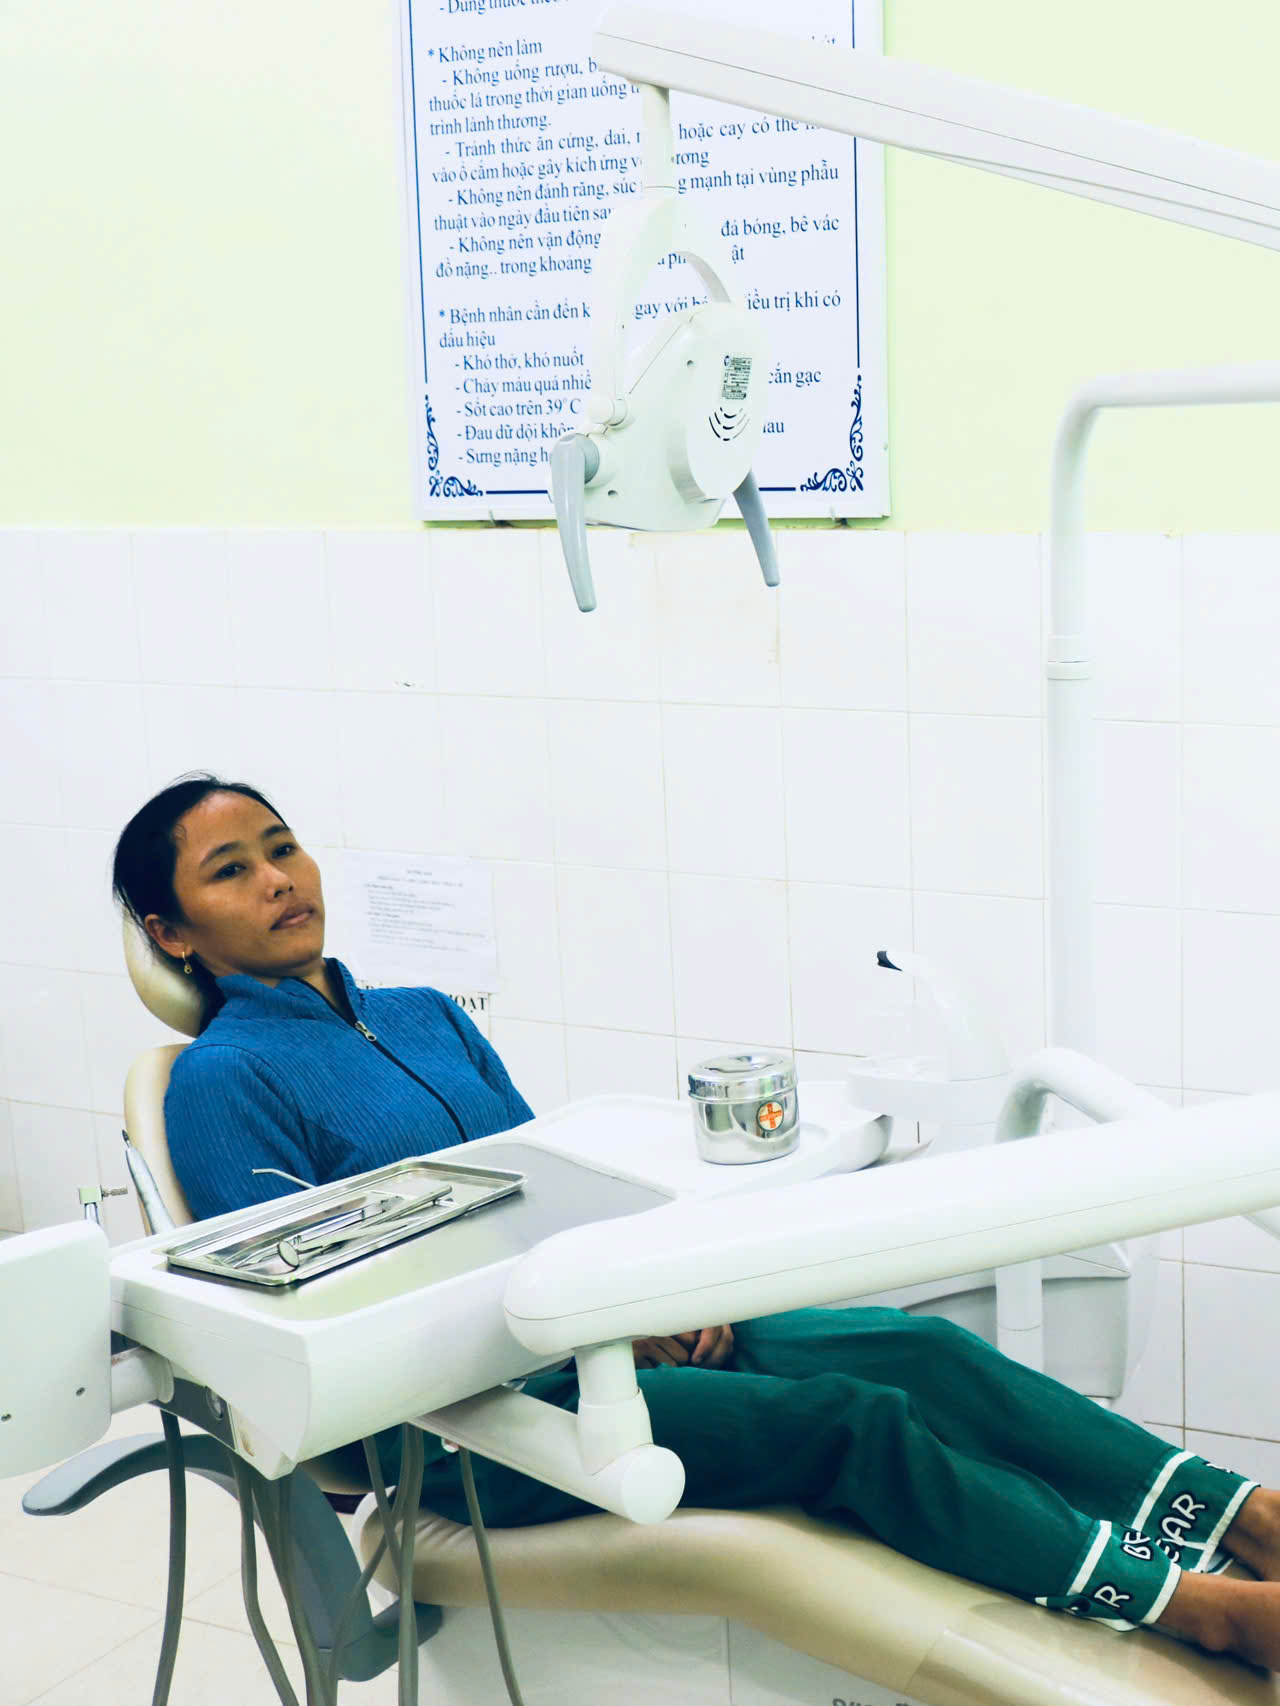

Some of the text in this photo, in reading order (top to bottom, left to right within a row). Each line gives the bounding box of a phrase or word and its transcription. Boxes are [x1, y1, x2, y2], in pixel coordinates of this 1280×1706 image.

[439, 45, 487, 63] Không
[488, 41, 513, 58] nên
[453, 66, 499, 86] Không
[470, 92, 483, 109] lá
[486, 92, 523, 109] trong
[557, 84, 588, 105] gian
[430, 118, 462, 136] trình
[455, 138, 496, 158] Tránh
[604, 128, 631, 146] dai,
[679, 123, 714, 142] hoặc
[719, 123, 746, 140] cay
[751, 116, 770, 134] có
[432, 167, 456, 183] vào
[502, 161, 534, 181] hoặc
[538, 157, 562, 180] gây
[566, 154, 597, 175] kích
[457, 187, 503, 208] Không
[506, 186, 531, 202] nên
[535, 182, 569, 201] đánh
[613, 177, 637, 195] súc
[690, 170, 732, 191] mạnh
[736, 170, 754, 189] tại
[759, 165, 797, 187] vùng
[434, 213, 468, 232] thuật
[470, 211, 496, 227] vào
[563, 203, 590, 222] tiên
[458, 213, 840, 256] Không nên vận động đá bóng, bê vác
[500, 260, 537, 277] trong
[450, 307, 486, 326] Bệnh
[489, 305, 523, 323] nhân
[633, 302, 661, 320] gay
[748, 288, 770, 310] iều
[774, 292, 790, 312] trị
[794, 290, 818, 309] khi
[823, 289, 841, 307] có
[466, 330, 496, 349] hiệu
[463, 353, 493, 371] Khó
[524, 351, 550, 369] khó
[562, 369, 592, 390] nhiề
[795, 371, 822, 388] gạc
[489, 403, 513, 417] cao
[516, 400, 543, 416] trên
[465, 425, 493, 441] Đau
[516, 424, 538, 442] dội
[466, 448, 501, 467] Sưng
[504, 448, 537, 466] nặng
[452, 994, 488, 1013] OẠT
